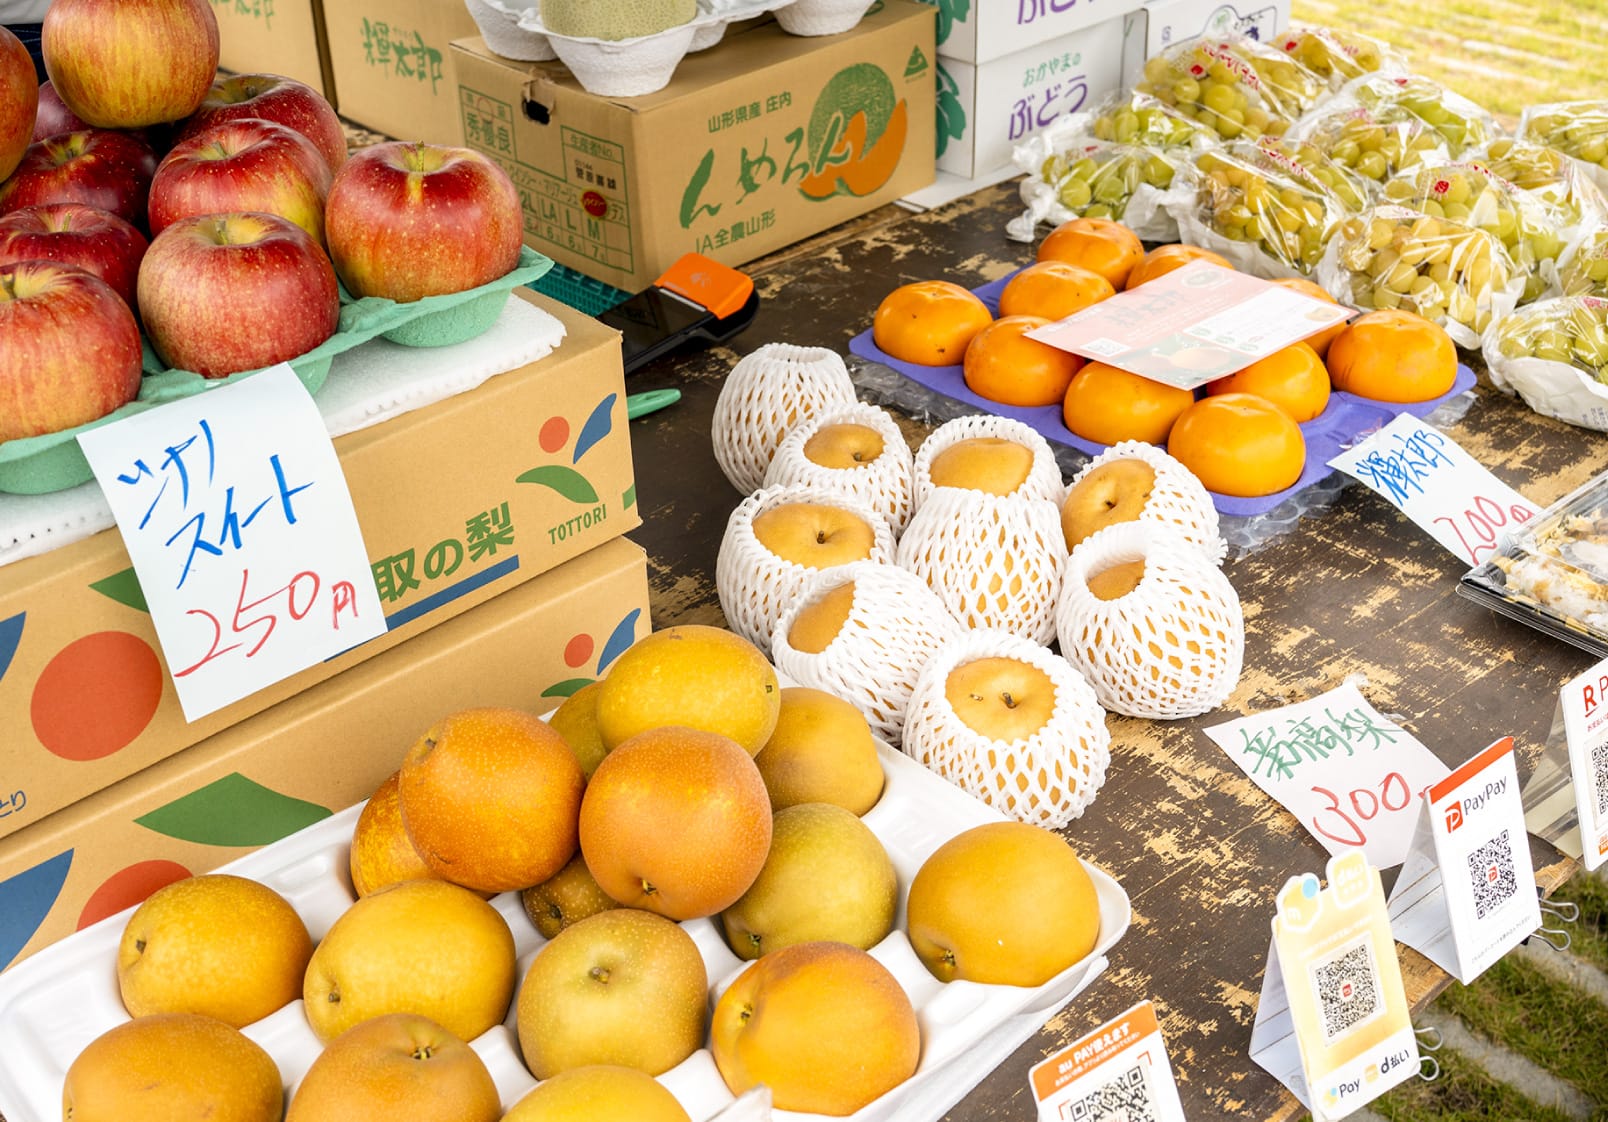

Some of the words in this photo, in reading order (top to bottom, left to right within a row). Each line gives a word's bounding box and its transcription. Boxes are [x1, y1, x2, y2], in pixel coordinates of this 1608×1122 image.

[1022, 52, 1082, 88] おかやまの
[707, 100, 763, 134] 山形県産
[765, 91, 792, 115] 庄内
[1008, 74, 1088, 141] ぶどう
[165, 454, 315, 591] スイート
[547, 508, 608, 545] TOTTORI
[173, 568, 359, 679] 250円
[1462, 776, 1508, 816] PayPay
[1379, 1049, 1410, 1075] d払い
[1338, 1078, 1361, 1098] Pay
